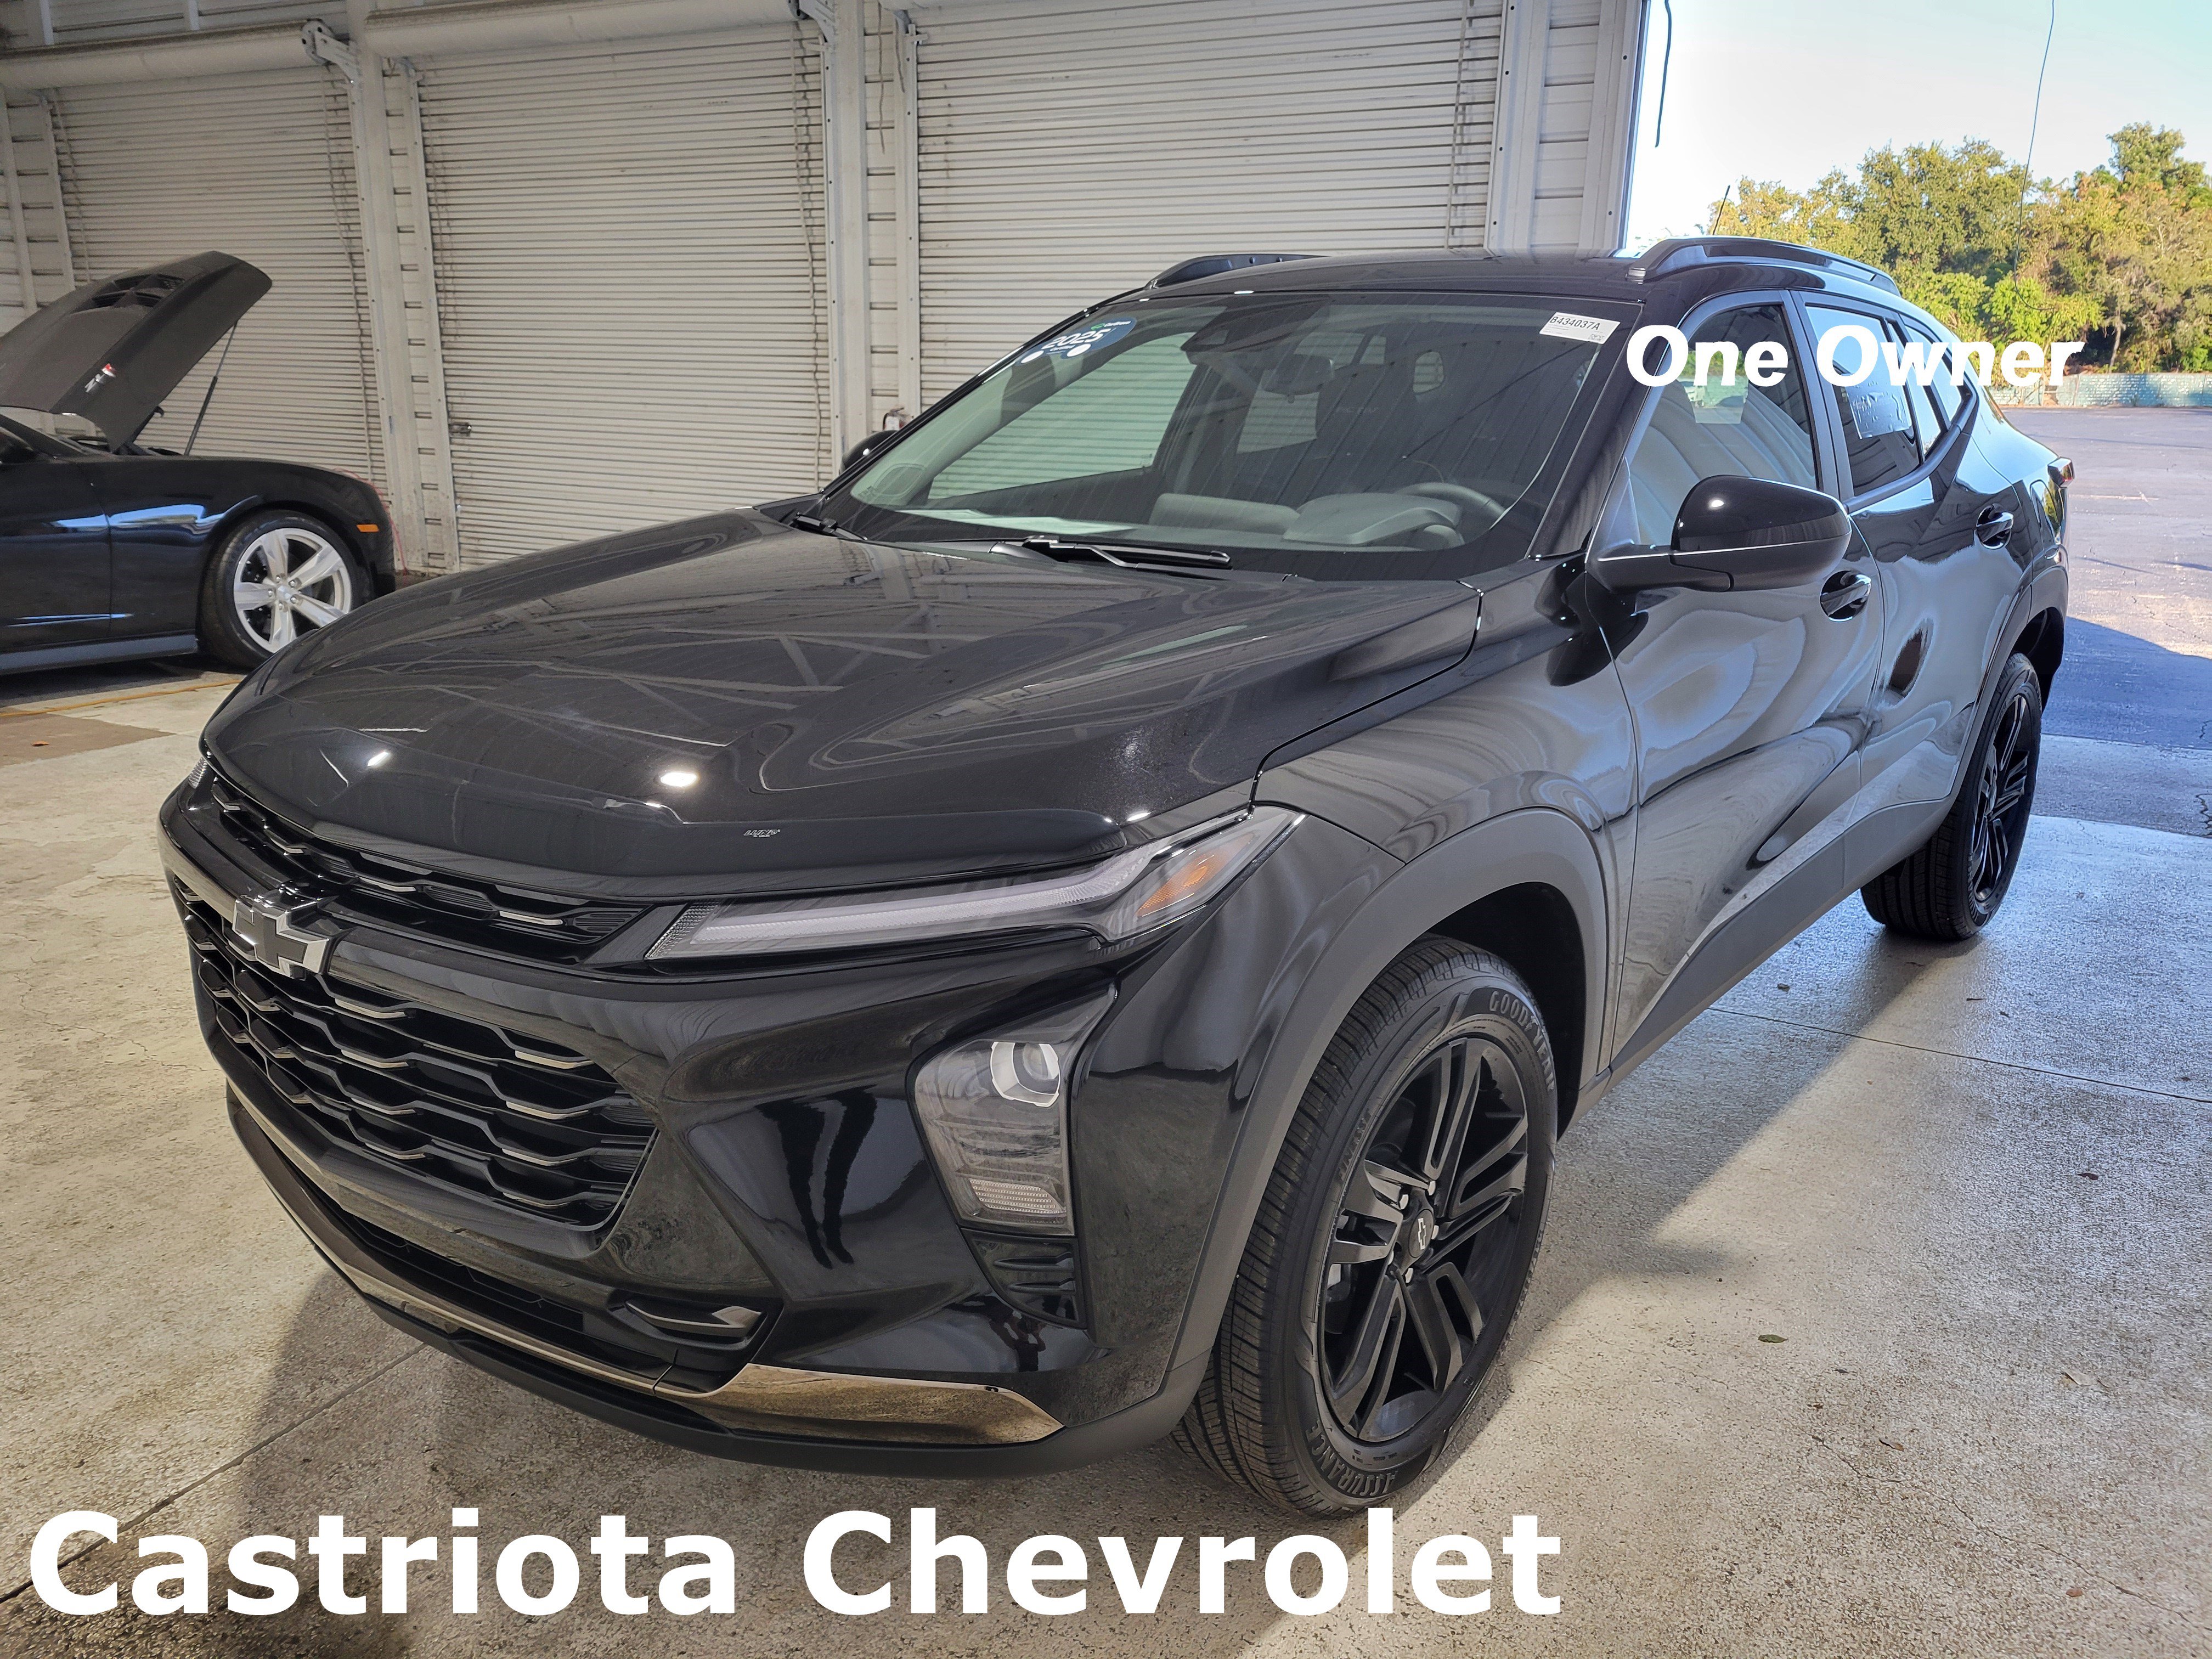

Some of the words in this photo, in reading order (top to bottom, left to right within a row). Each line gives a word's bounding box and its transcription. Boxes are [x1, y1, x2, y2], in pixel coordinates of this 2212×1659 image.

[1041, 328, 1112, 350] 2025
[1549, 316, 1601, 330] B434037A
[1489, 990, 1555, 1091] GOODYEAR
[1305, 1425, 1398, 1496] ASSURANCE
